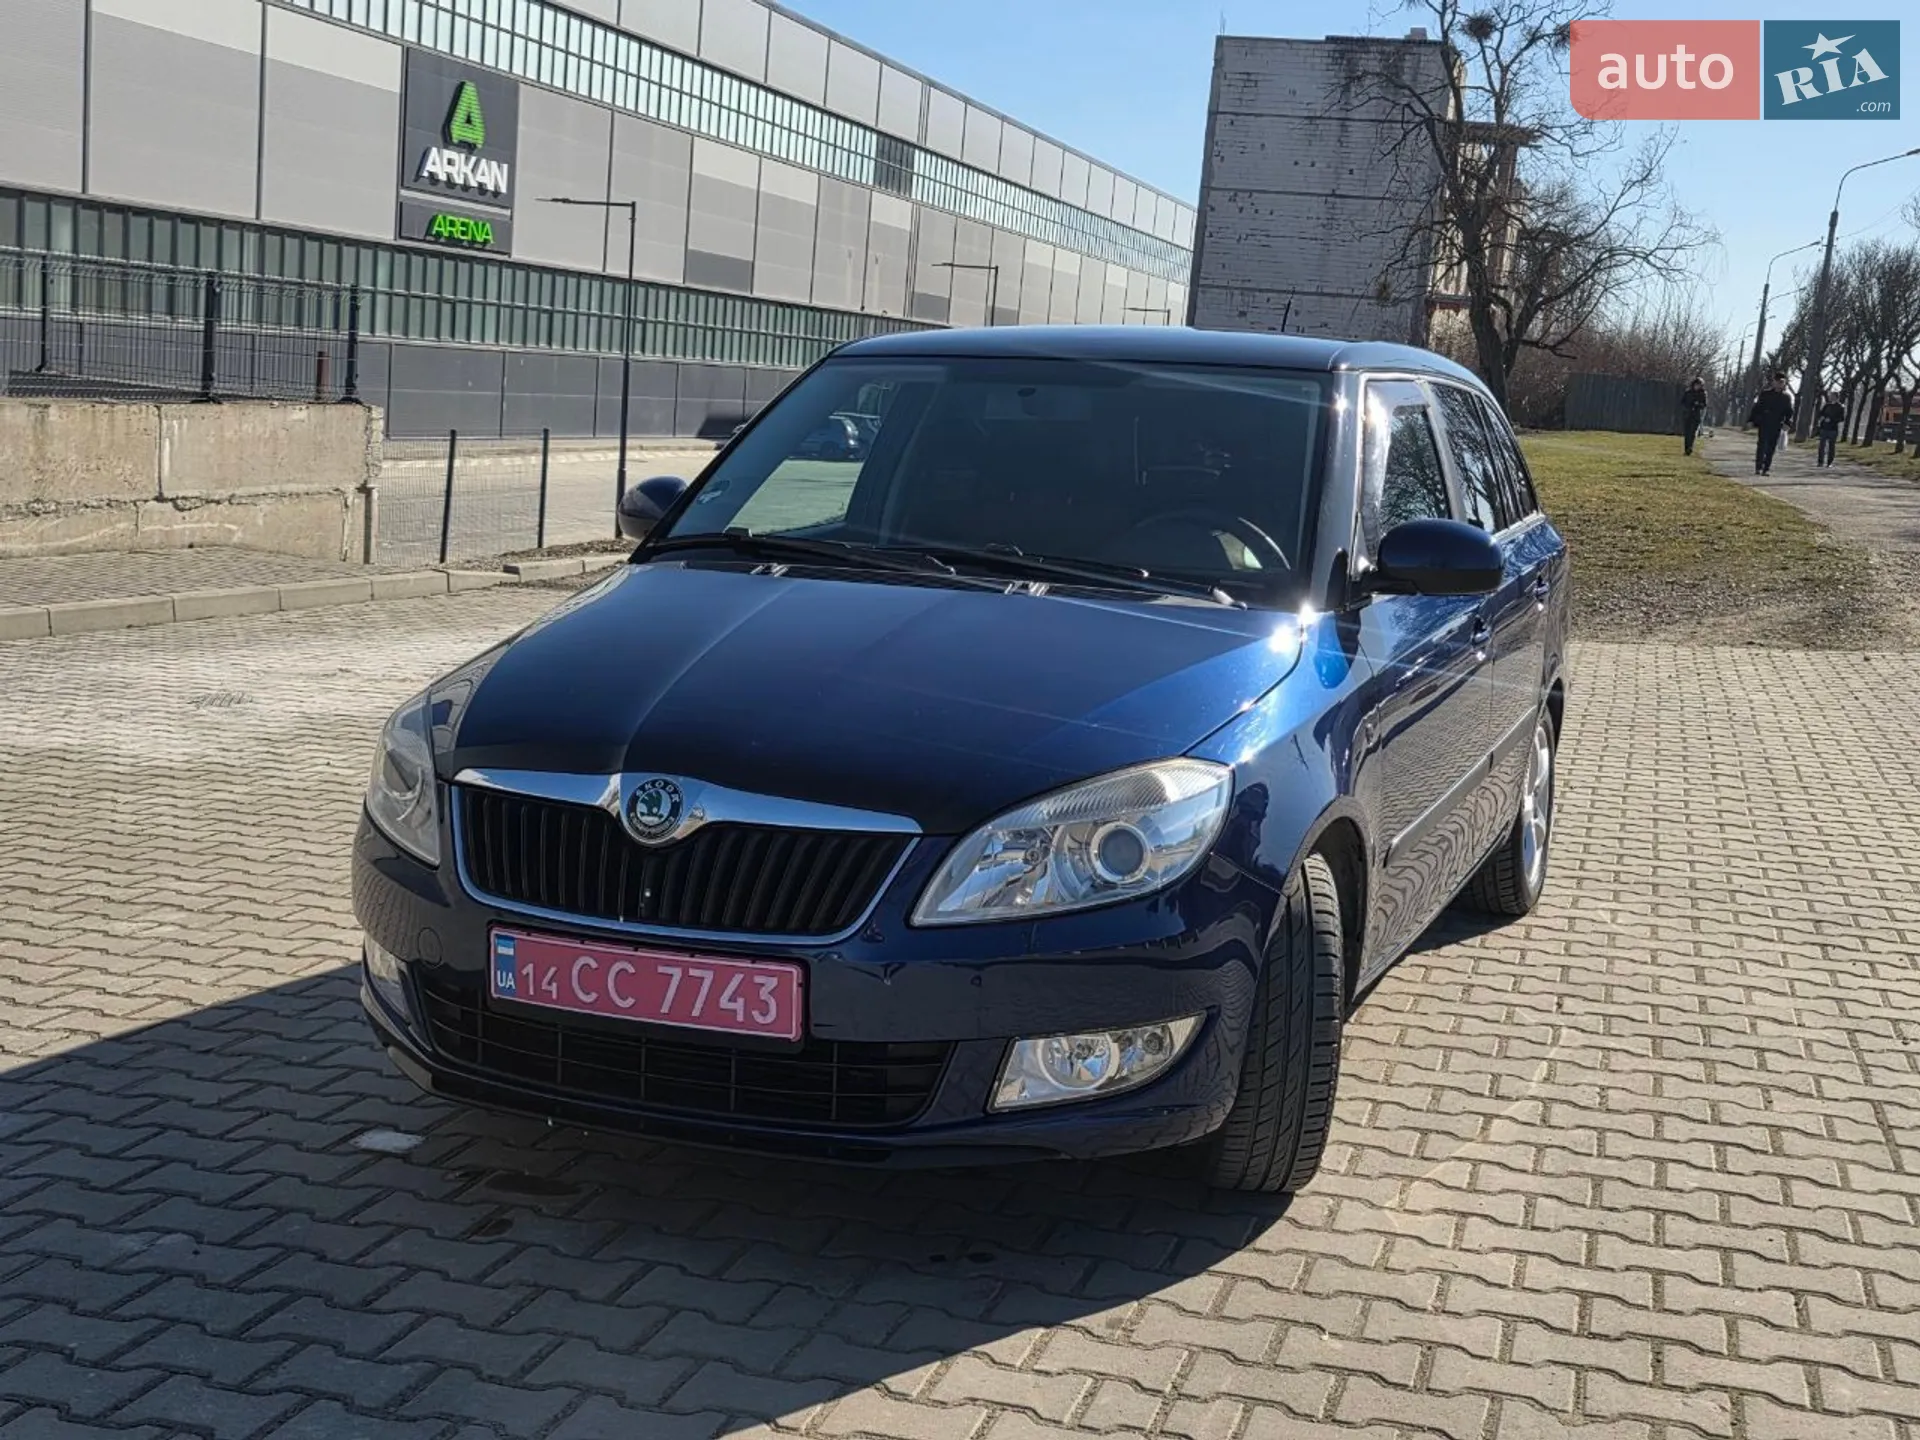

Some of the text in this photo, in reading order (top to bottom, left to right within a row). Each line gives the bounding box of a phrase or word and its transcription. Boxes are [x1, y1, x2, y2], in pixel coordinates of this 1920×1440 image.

[421, 147, 509, 194] ARKAN
[431, 214, 495, 244] ARENA
[497, 969, 516, 990] UA
[520, 955, 779, 1025] 14 CC 7743
